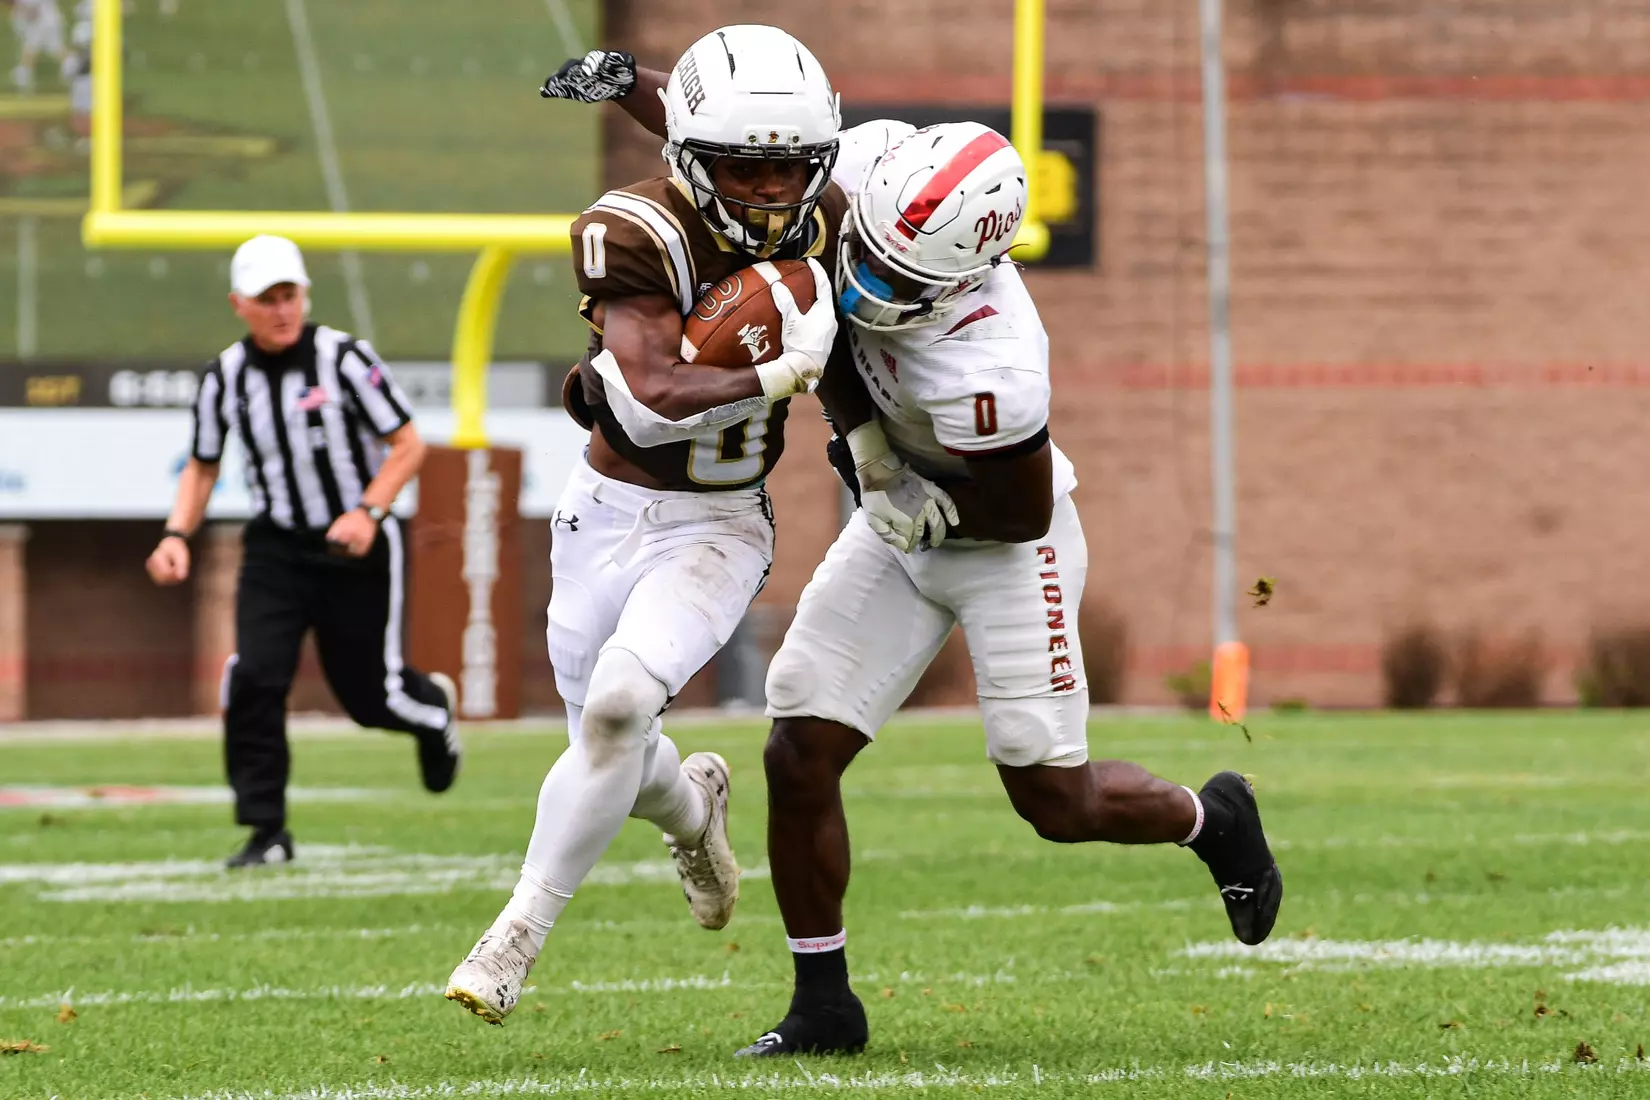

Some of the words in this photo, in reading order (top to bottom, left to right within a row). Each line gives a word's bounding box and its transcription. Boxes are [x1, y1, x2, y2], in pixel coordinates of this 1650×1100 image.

[677, 48, 706, 117] EHIGH
[581, 222, 608, 279] 0
[974, 197, 1022, 254] Pios
[974, 391, 998, 437] 0
[1036, 544, 1076, 693] PIONEER
